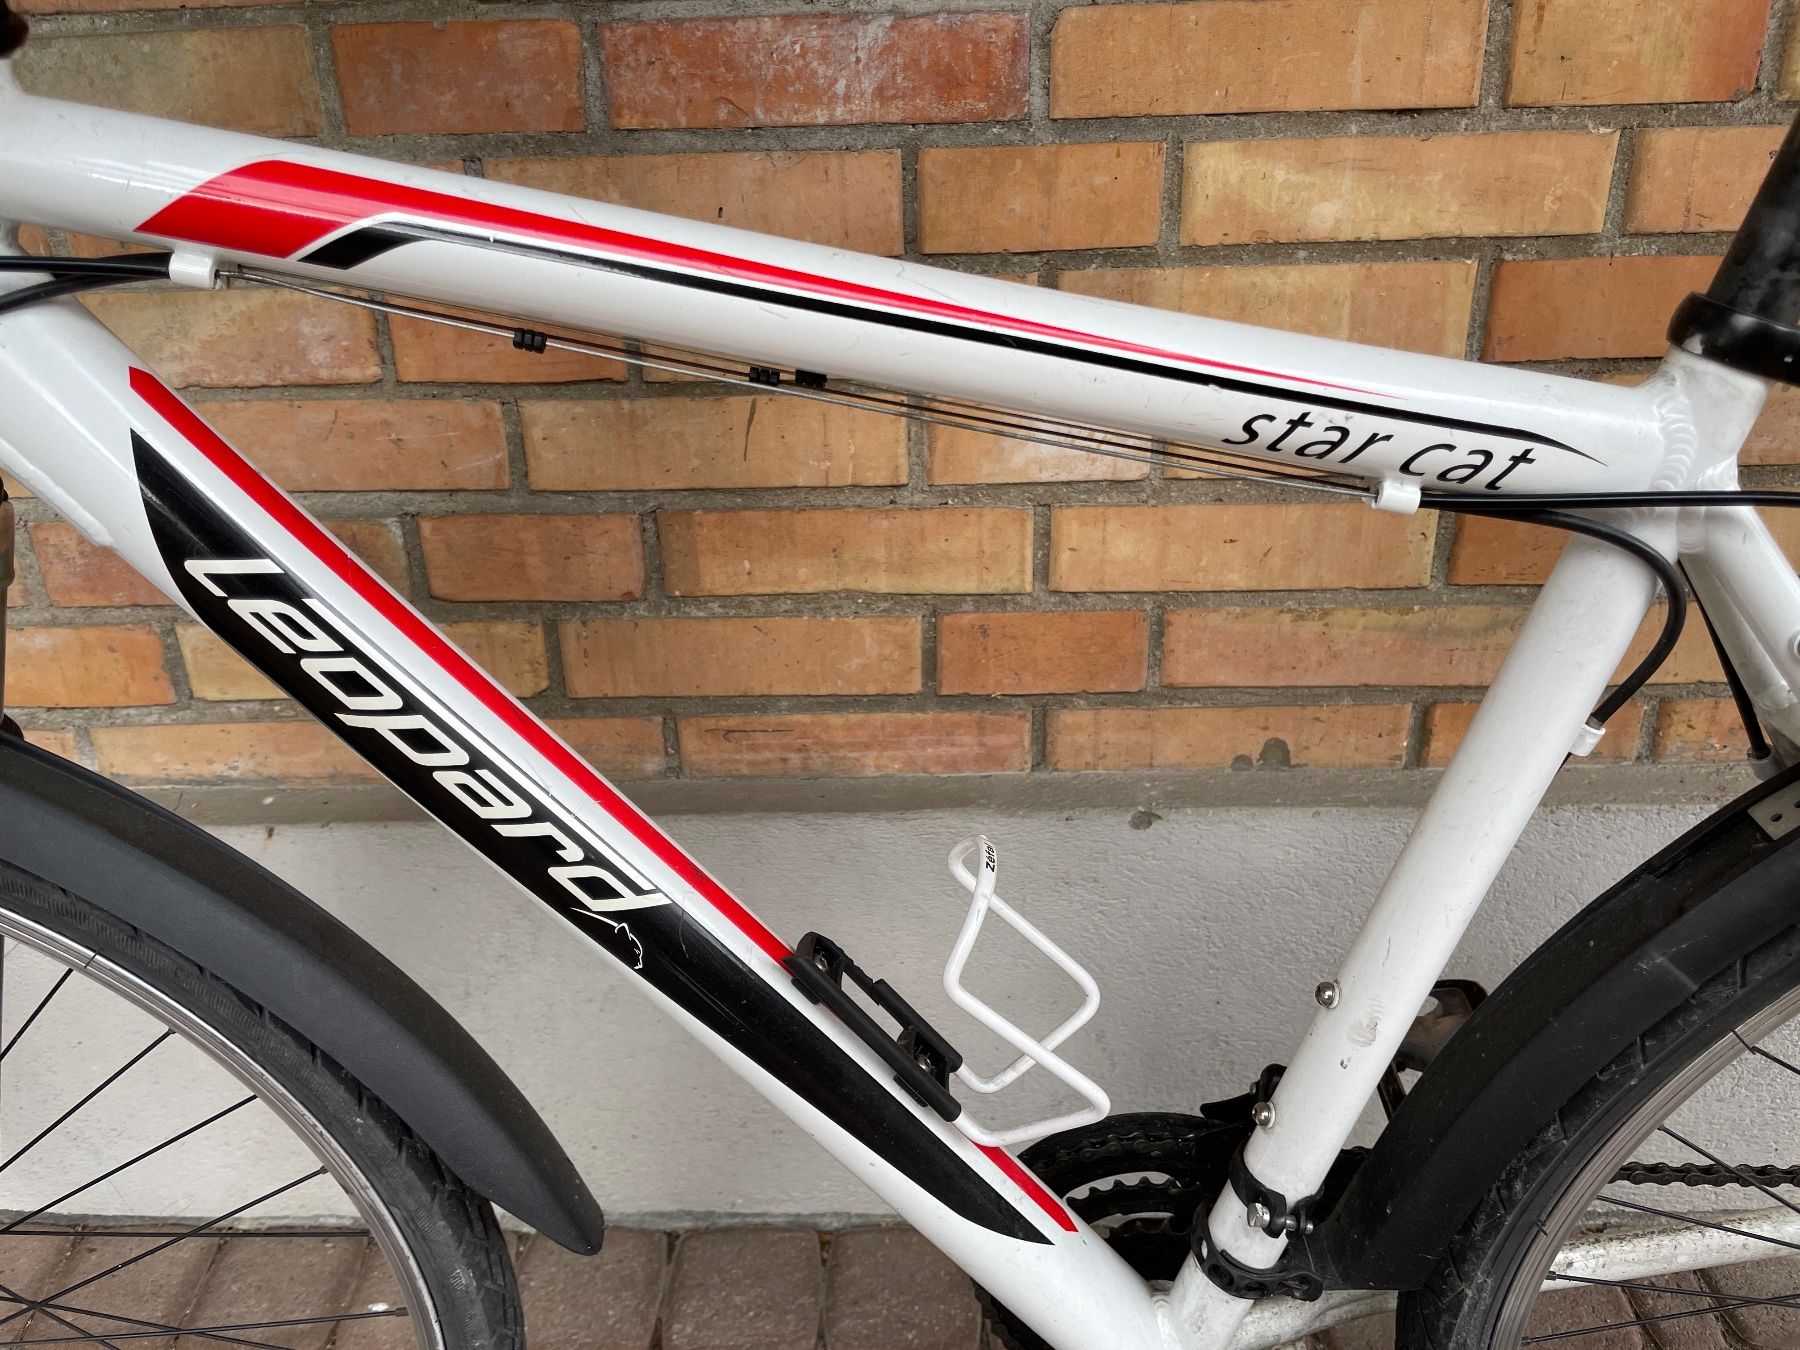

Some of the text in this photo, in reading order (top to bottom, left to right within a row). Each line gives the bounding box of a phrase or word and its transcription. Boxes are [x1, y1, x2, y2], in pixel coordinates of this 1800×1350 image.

[1221, 411, 1536, 491] star cat
[184, 559, 673, 911] Leopard
